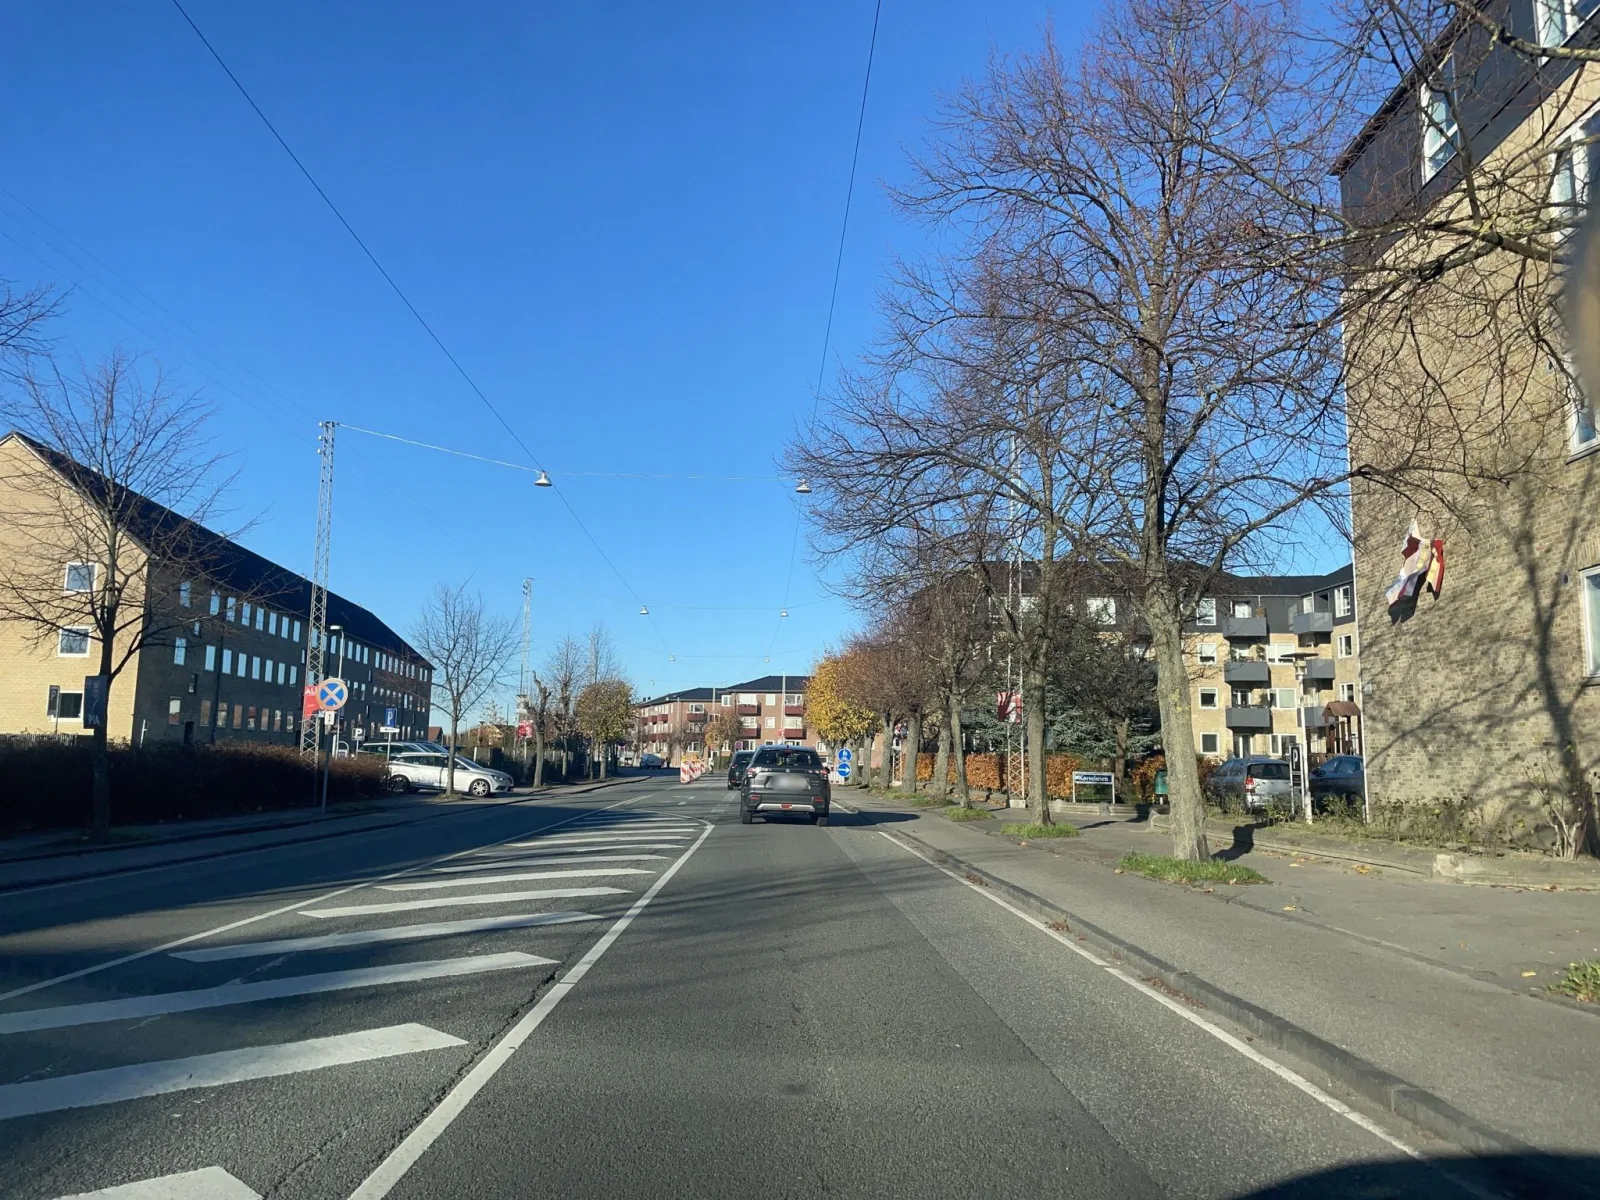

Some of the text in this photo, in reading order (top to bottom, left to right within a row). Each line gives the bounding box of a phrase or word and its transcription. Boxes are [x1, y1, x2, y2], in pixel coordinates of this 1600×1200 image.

[387, 711, 393, 725] P
[355, 728, 363, 737] P
[1293, 749, 1299, 769] P
